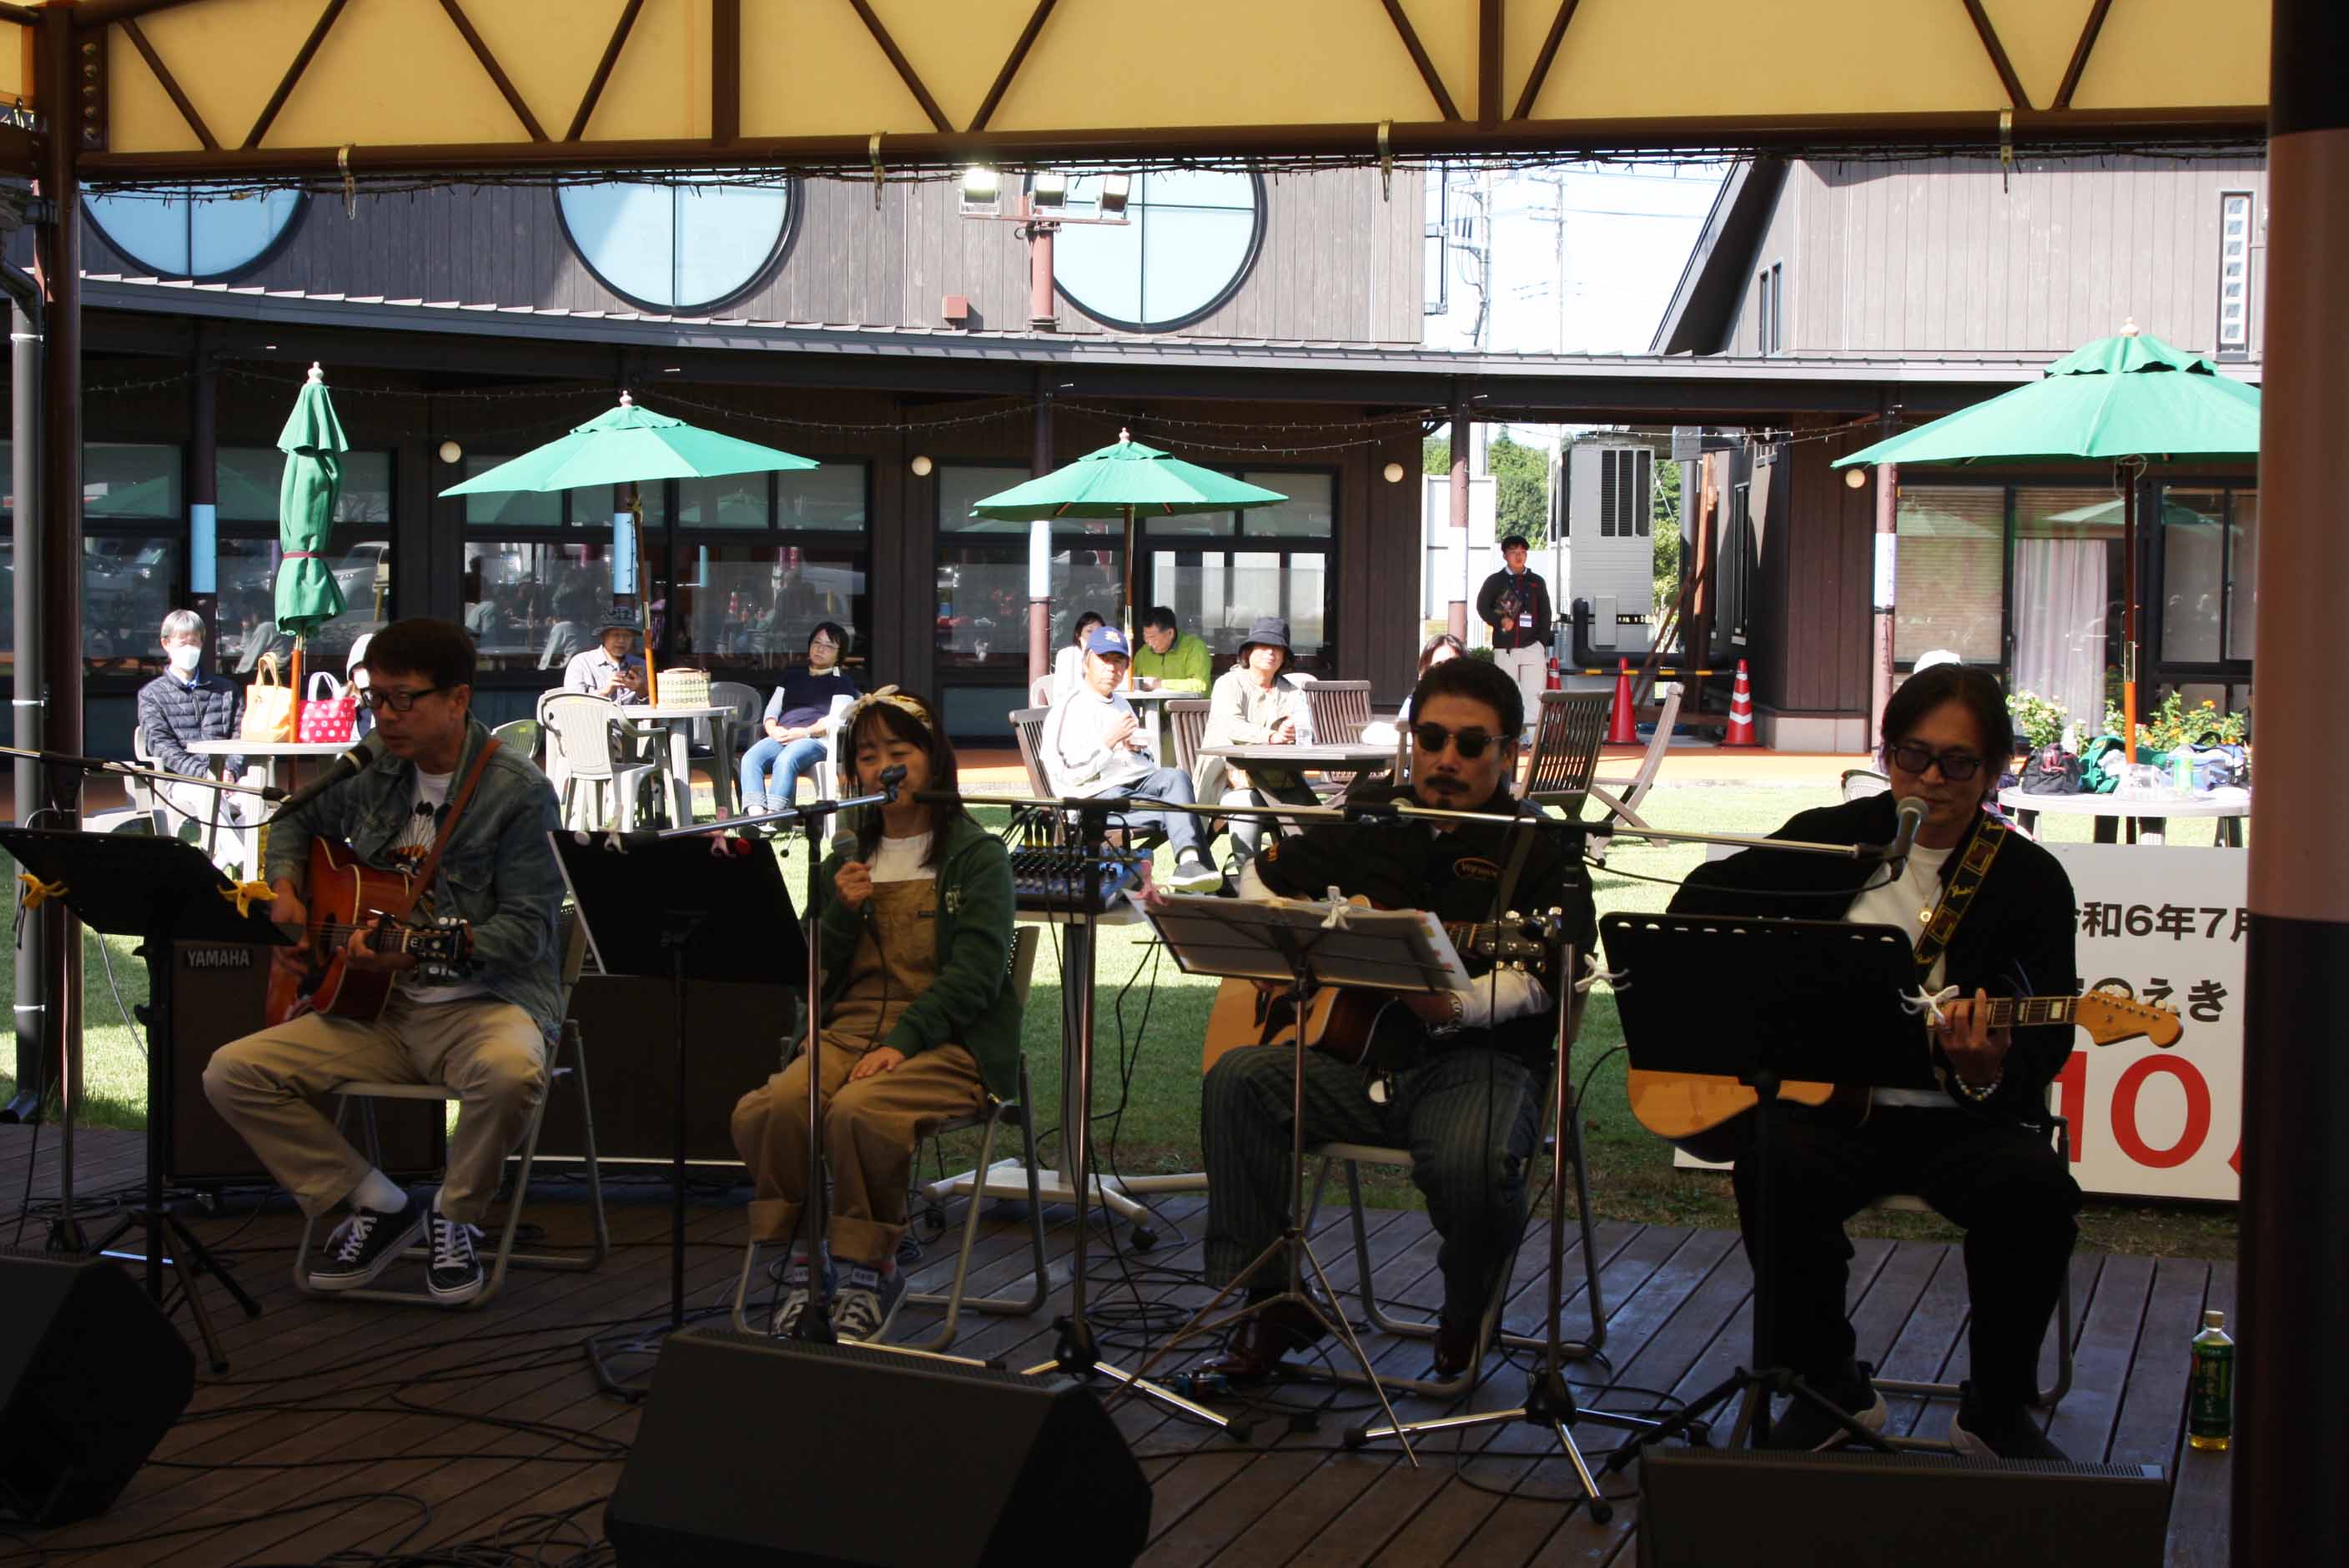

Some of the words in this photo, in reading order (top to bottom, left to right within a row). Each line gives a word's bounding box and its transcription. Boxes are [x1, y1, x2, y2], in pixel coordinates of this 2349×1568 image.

[2075, 902, 2250, 942] 和6年7月
[187, 947, 251, 968] YAMAHA
[2051, 1050, 2243, 1176] 10
